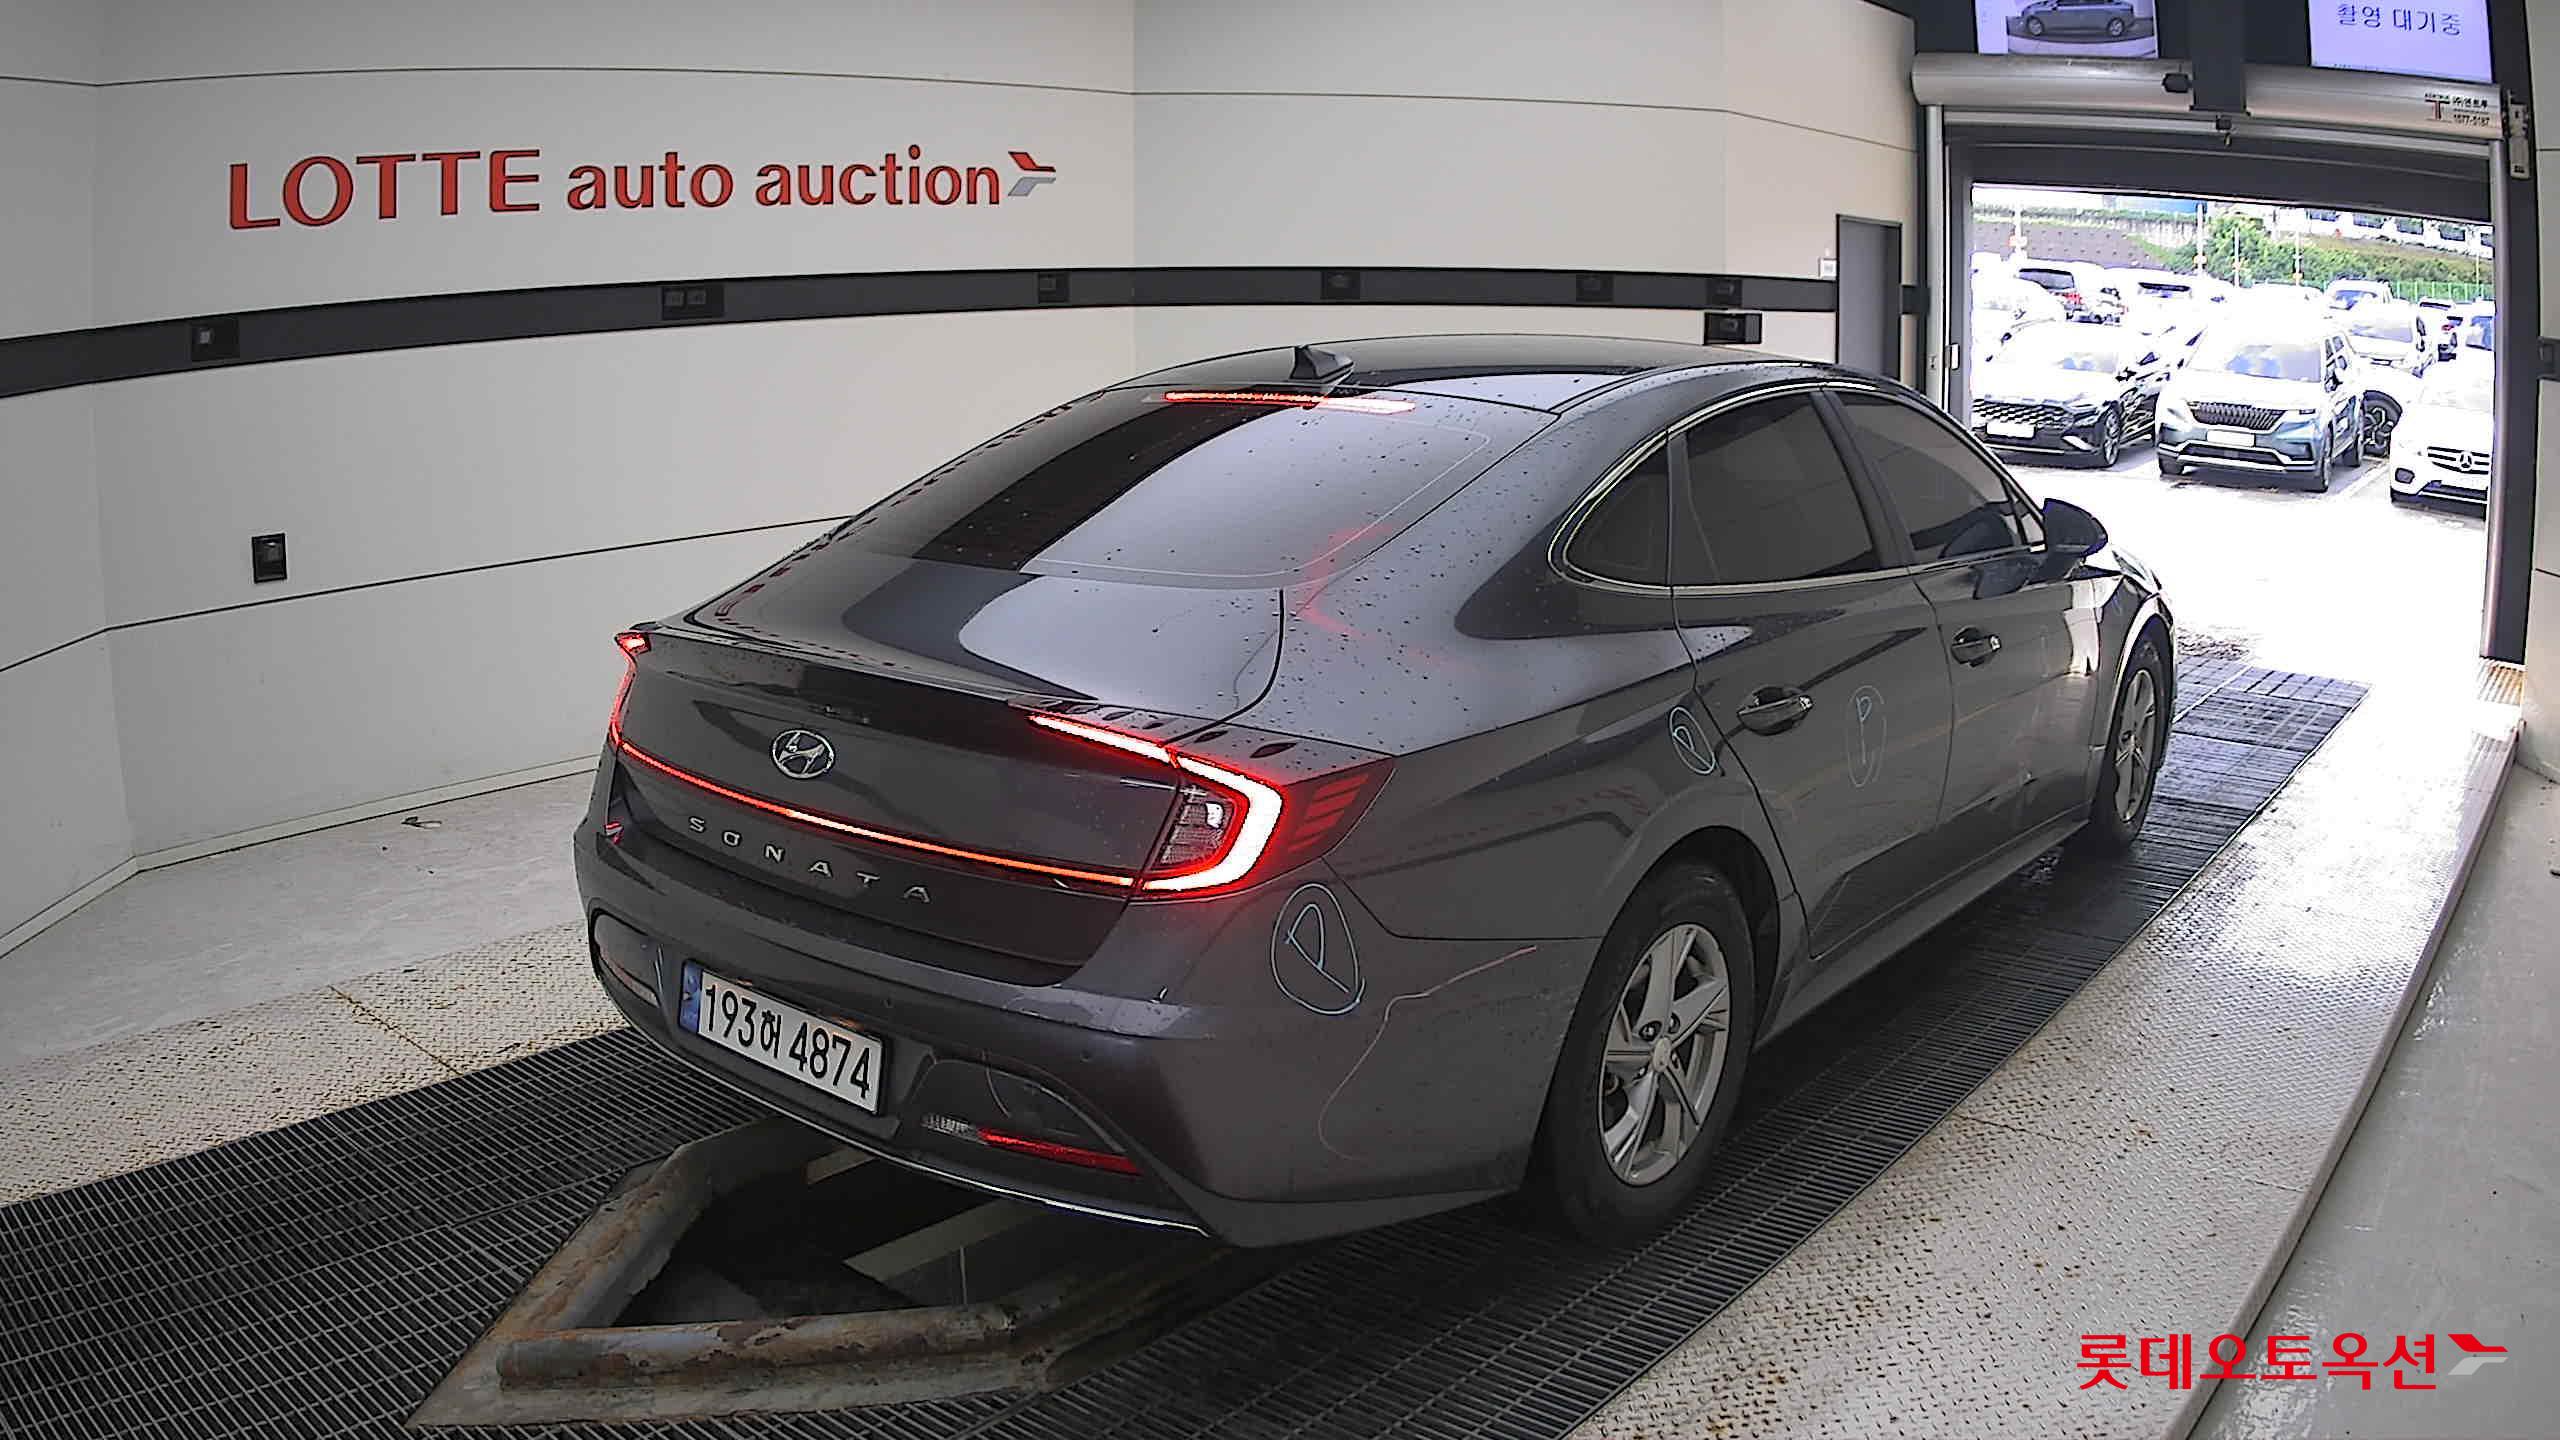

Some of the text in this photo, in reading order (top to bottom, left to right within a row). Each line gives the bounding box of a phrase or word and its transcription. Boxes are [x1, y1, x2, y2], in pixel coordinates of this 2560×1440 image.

[2337, 3, 2461, 36] 촬영 대기중
[230, 145, 1001, 230] LOTTE auto auction
[688, 815, 932, 904] SONATA
[705, 984, 871, 1099] 193허 4874
